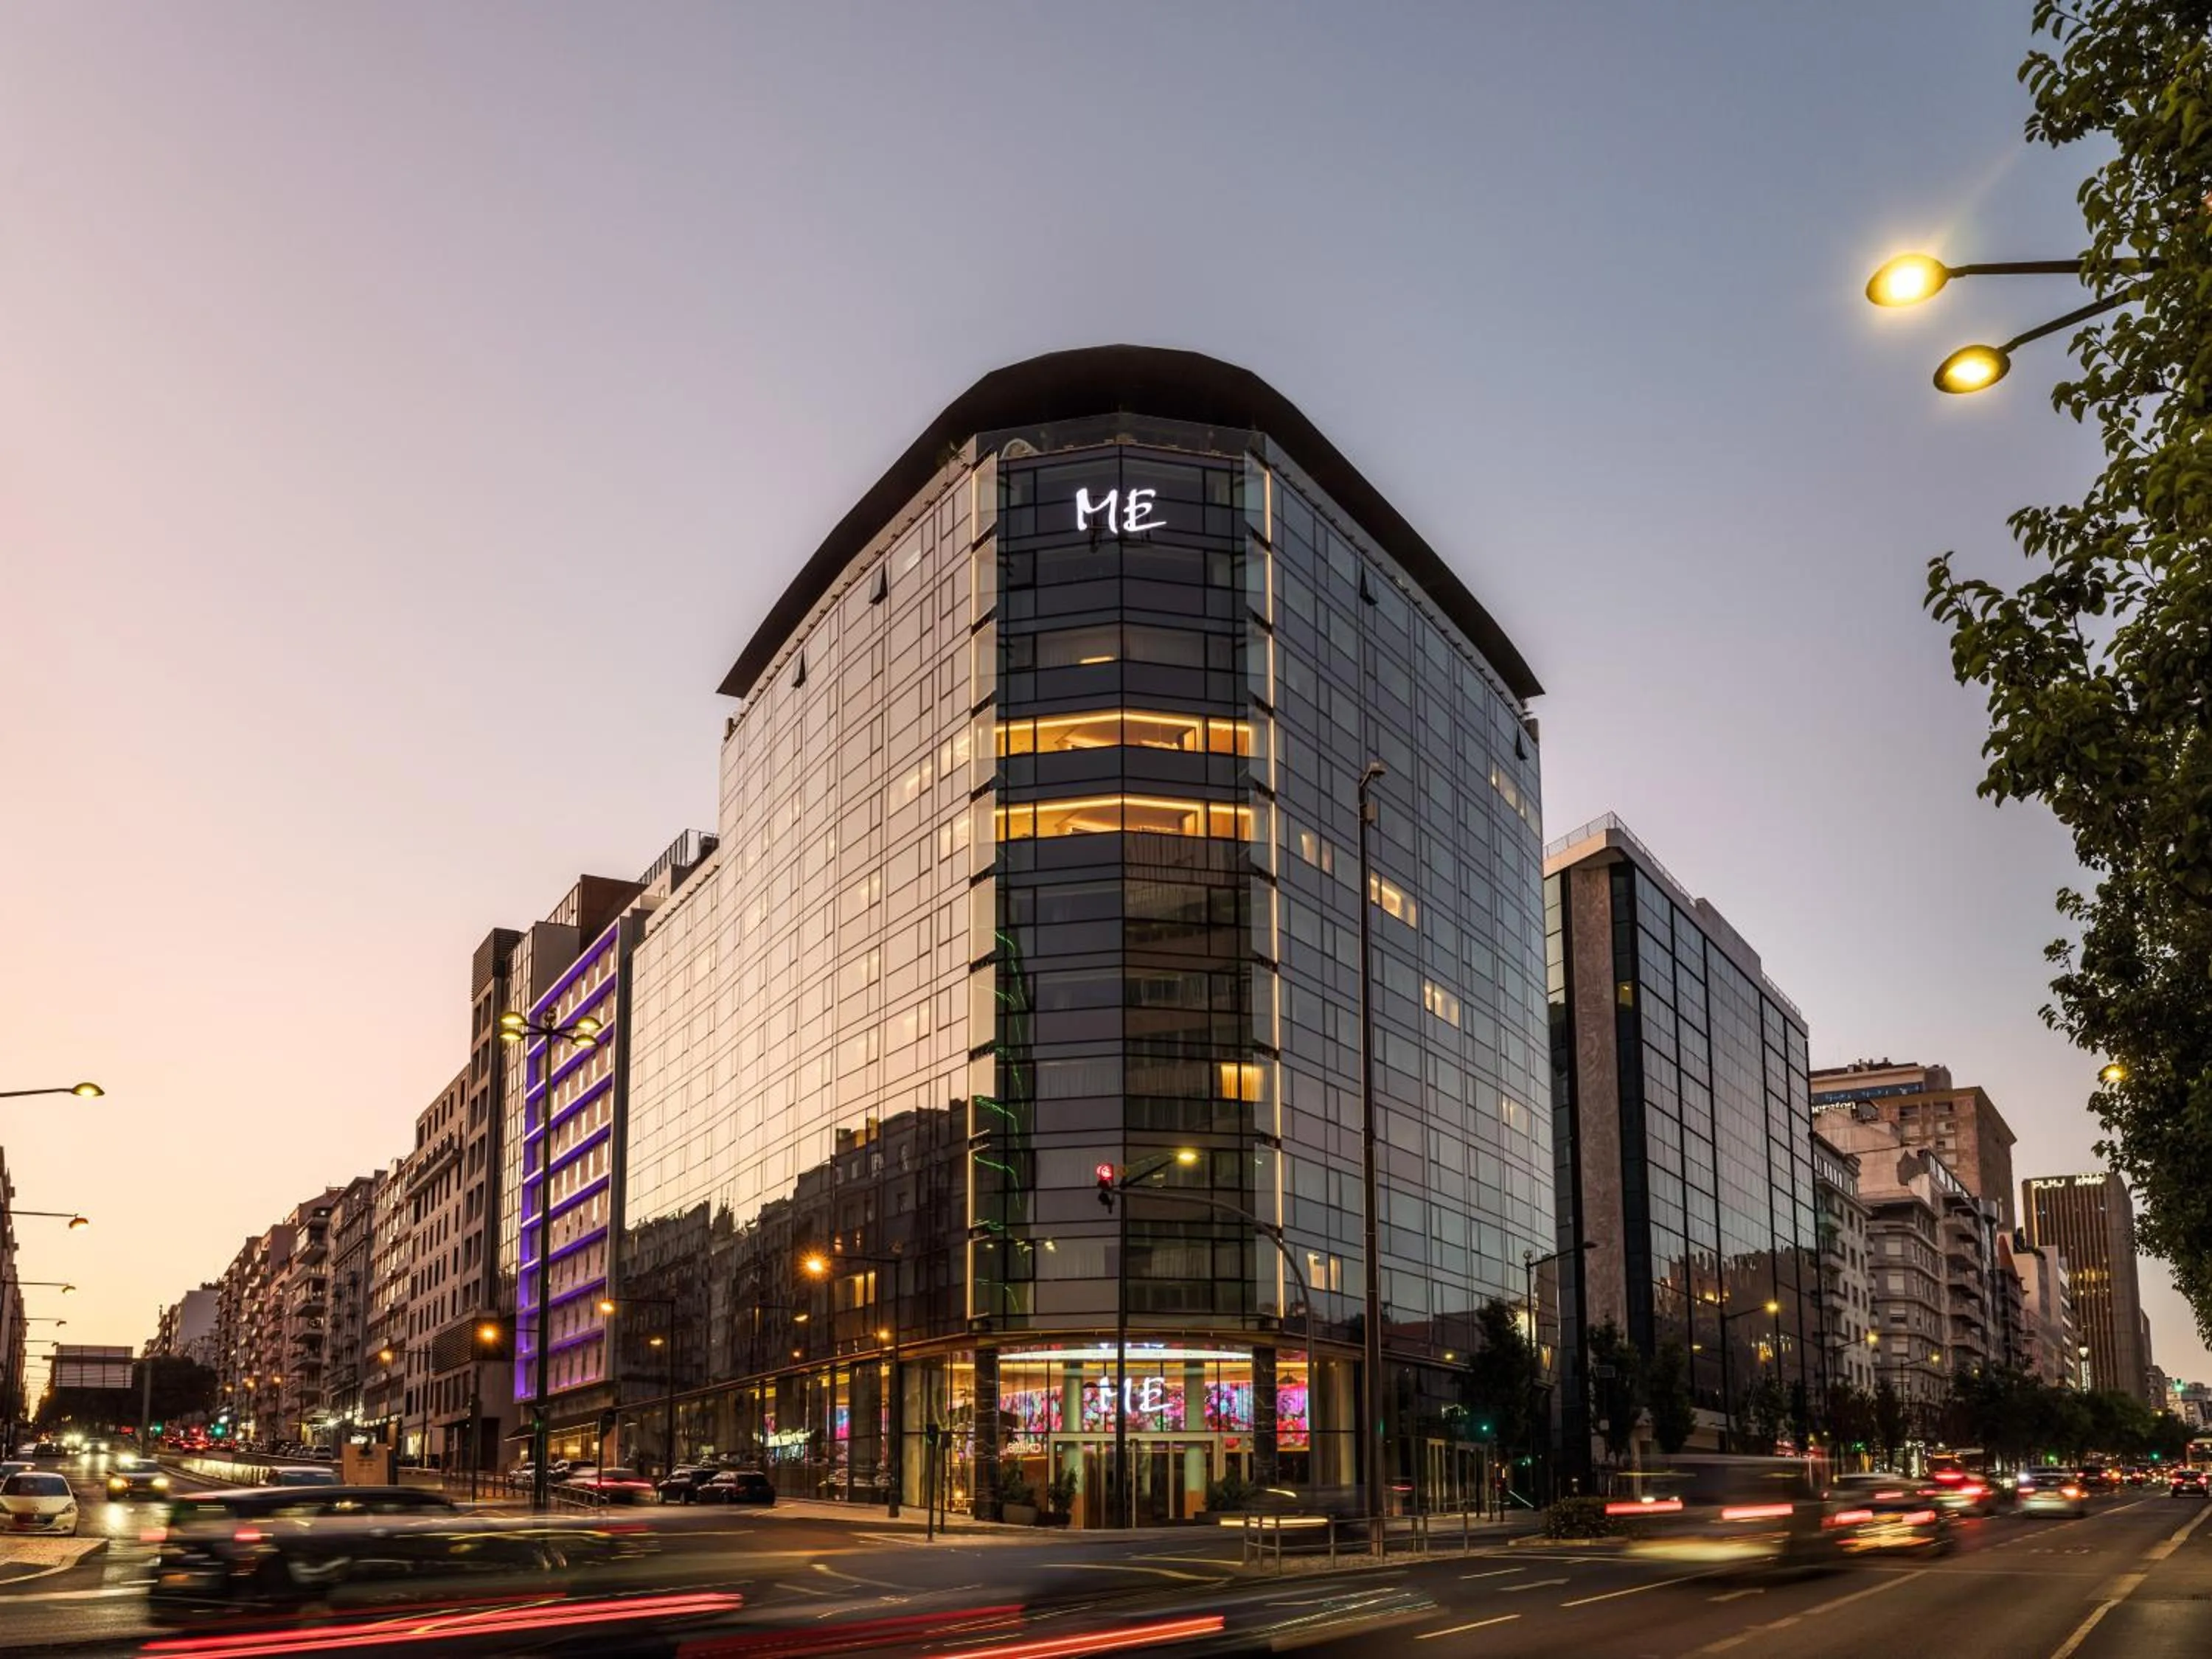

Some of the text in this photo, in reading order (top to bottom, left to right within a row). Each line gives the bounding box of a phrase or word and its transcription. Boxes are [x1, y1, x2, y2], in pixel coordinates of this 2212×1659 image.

[1076, 487, 1167, 535] ME
[2031, 1179, 2065, 1189] PLMJ
[1099, 1377, 1175, 1413] ME
